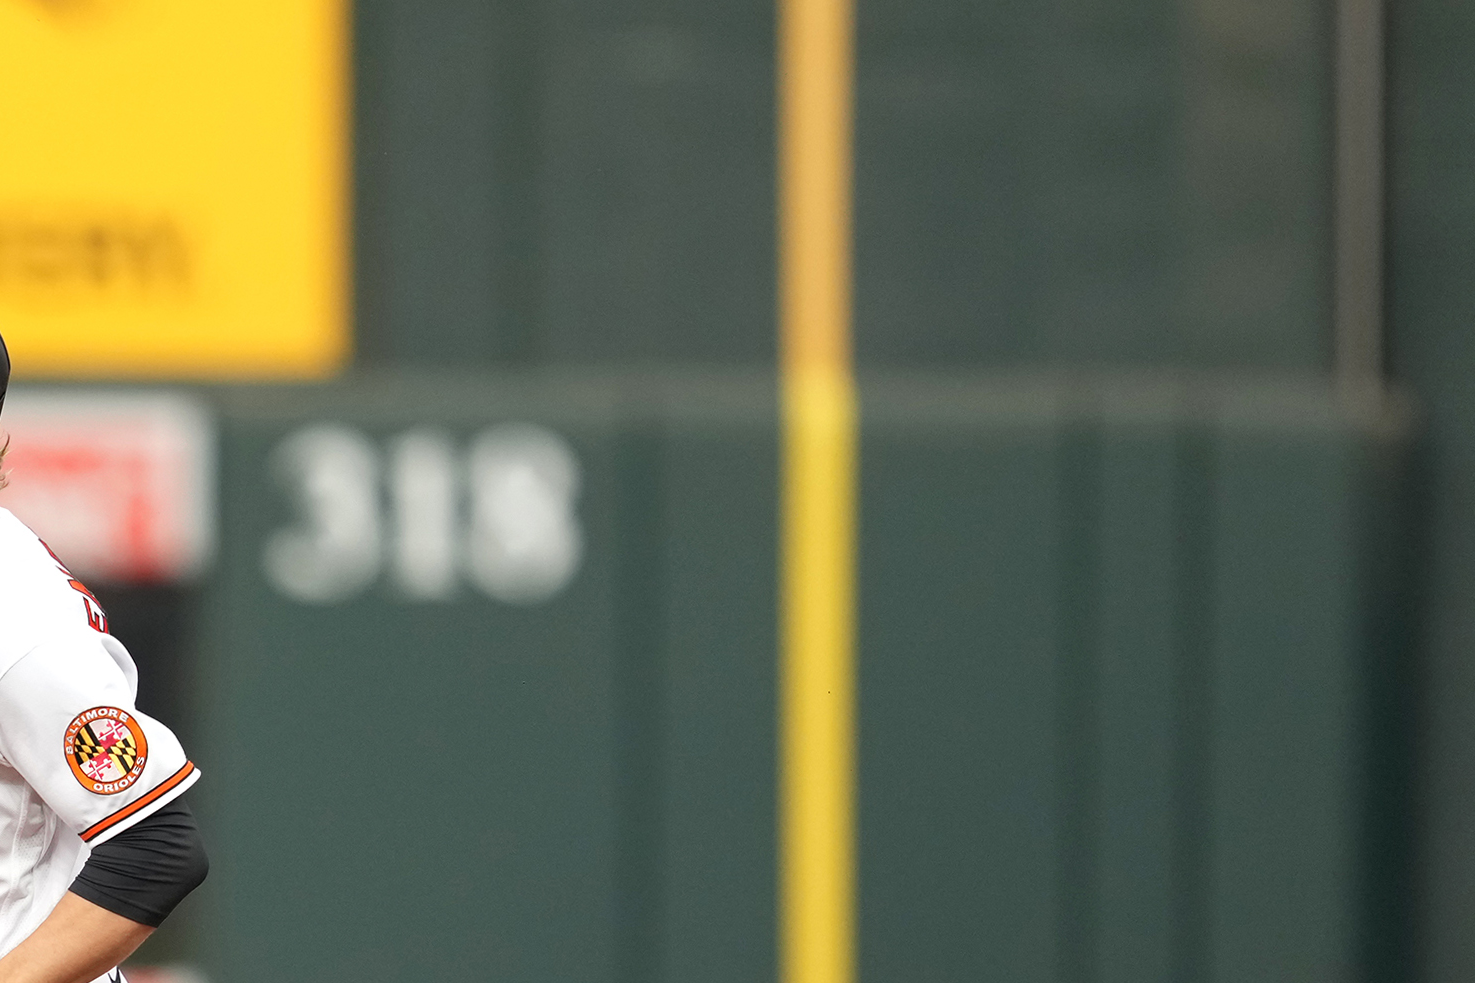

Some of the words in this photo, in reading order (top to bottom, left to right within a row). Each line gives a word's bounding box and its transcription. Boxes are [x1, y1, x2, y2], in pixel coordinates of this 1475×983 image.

[264, 422, 581, 602] 318
[66, 708, 129, 755] BALTIMORE
[93, 727, 145, 793] ORIOLES
